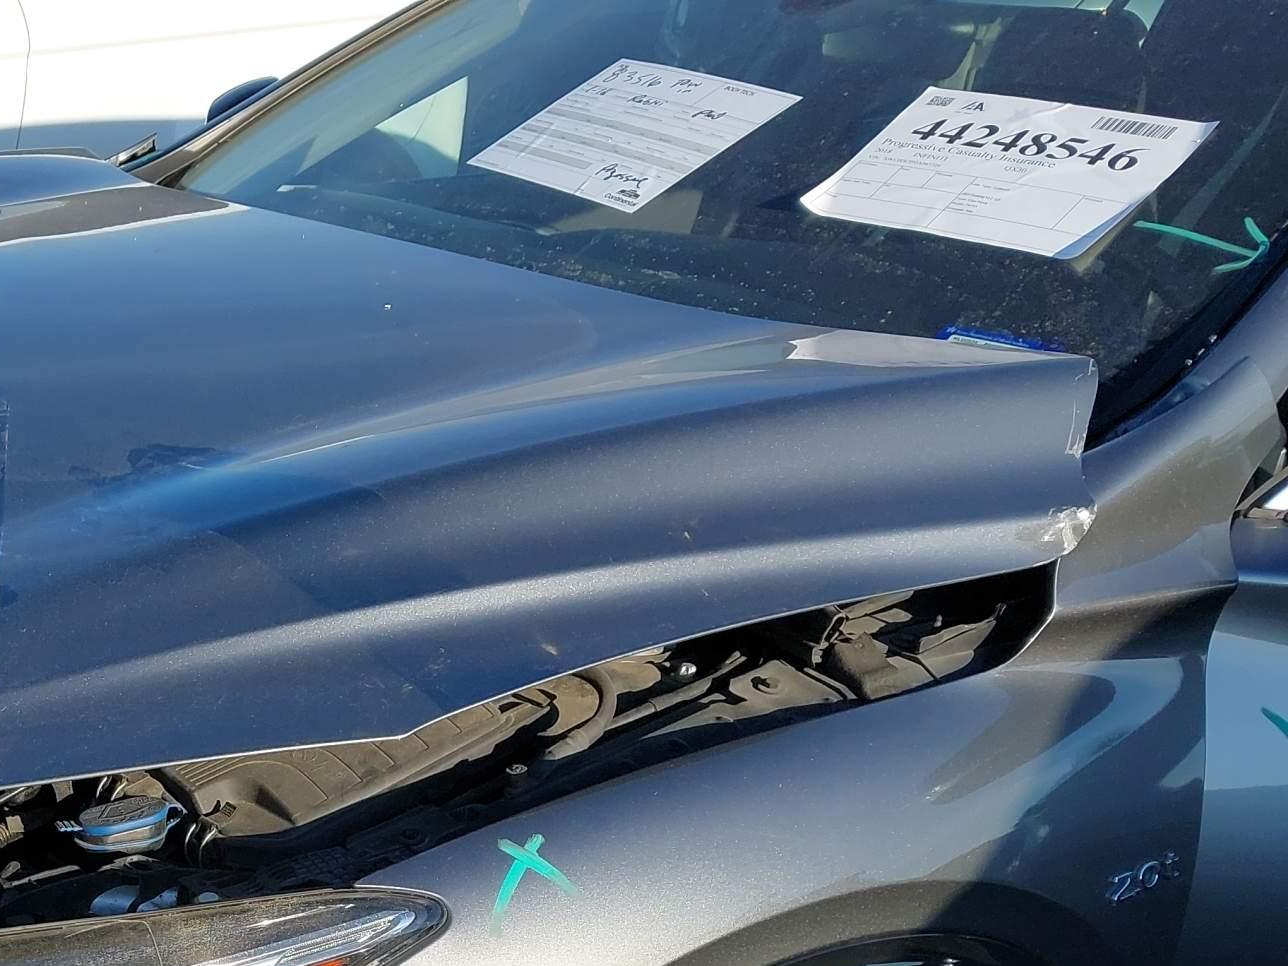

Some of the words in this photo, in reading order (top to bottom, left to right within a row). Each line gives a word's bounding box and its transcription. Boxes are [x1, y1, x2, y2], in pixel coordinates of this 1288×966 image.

[881, 137, 946, 155] Progressive
[948, 146, 996, 161] Casualty
[998, 154, 1057, 169] Insurance
[912, 118, 1152, 171] 44248546
